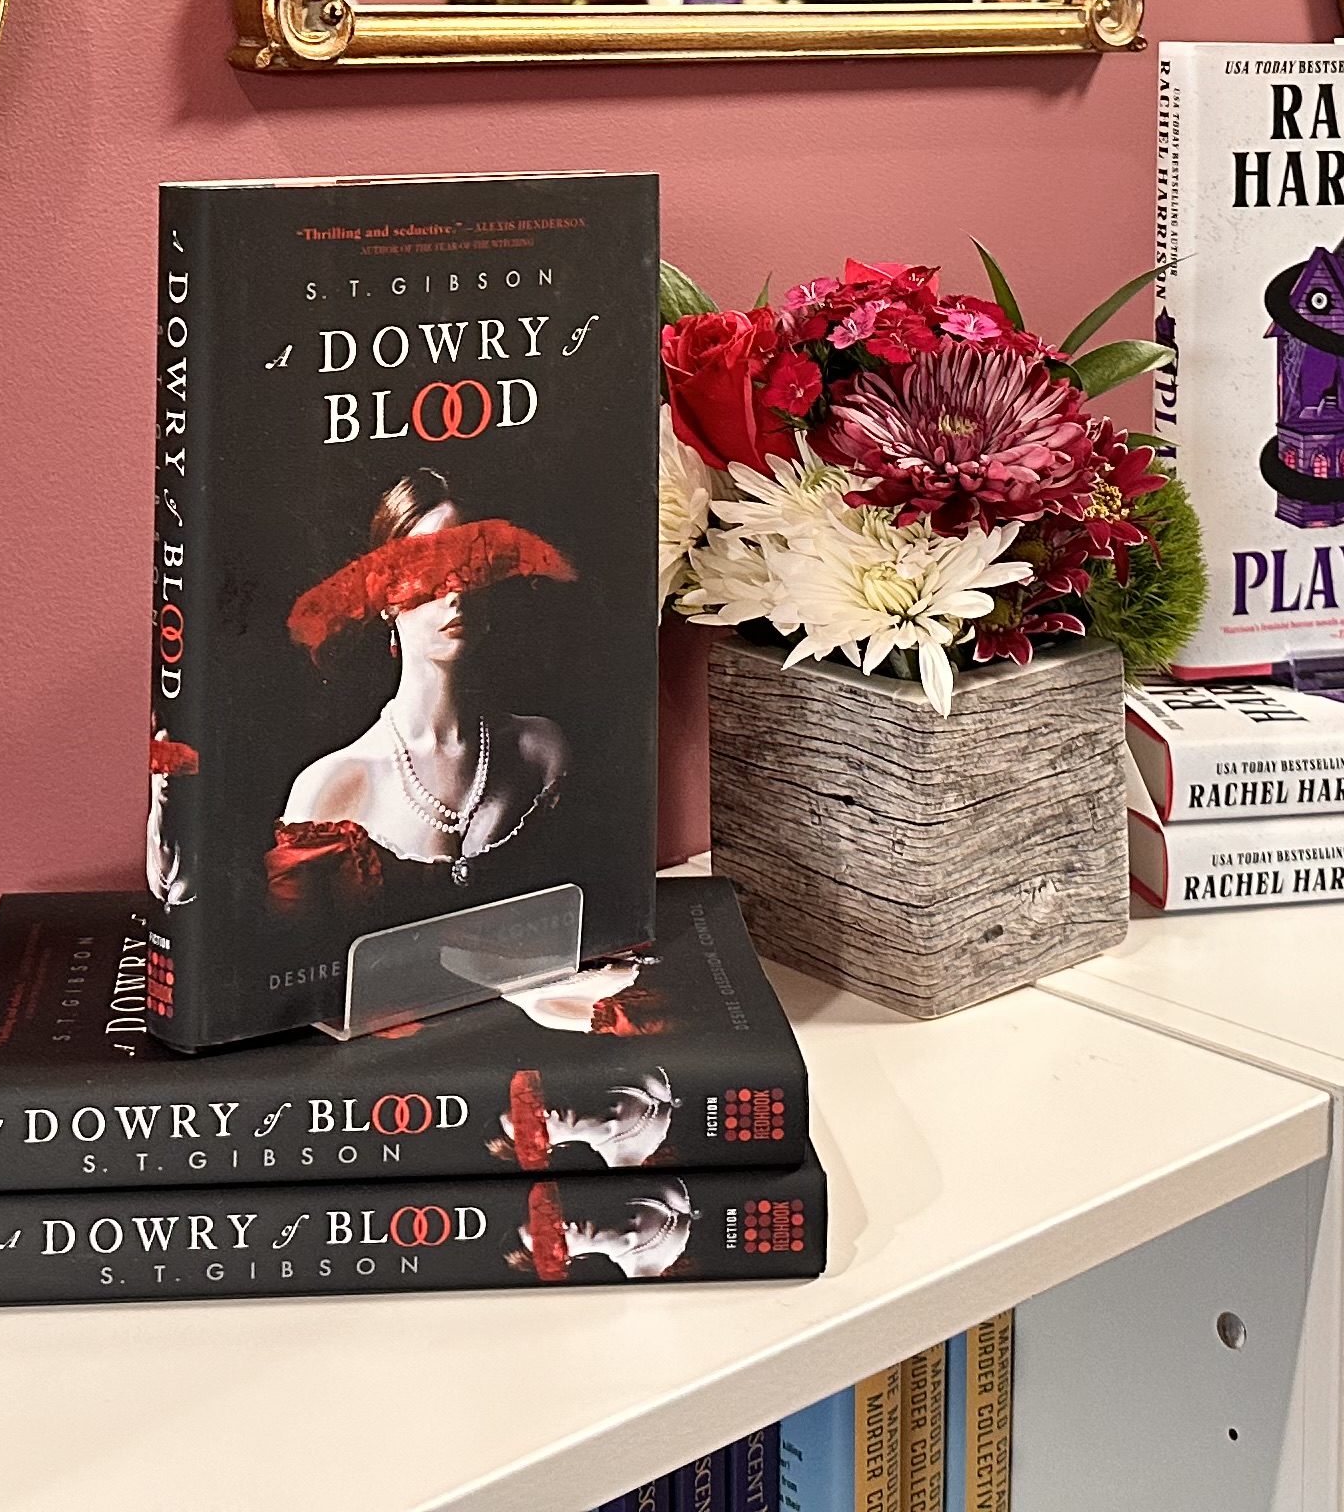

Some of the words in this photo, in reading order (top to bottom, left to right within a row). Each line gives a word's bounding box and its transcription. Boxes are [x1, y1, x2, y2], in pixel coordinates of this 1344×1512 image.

[1225, 60, 1249, 75] USA
[1255, 60, 1297, 74] TODAY
[1158, 60, 1171, 159] RACHEL
[365, 226, 389, 239] and
[518, 218, 587, 231] HENDERSON
[1155, 169, 1169, 300] HARRISON
[306, 282, 327, 300] S.
[349, 279, 371, 297] T.
[391, 268, 553, 295] GIBSON
[265, 343, 294, 371] A
[318, 315, 550, 373] DOWRY
[562, 313, 599, 357] of
[165, 271, 188, 477] DOWRY
[323, 378, 538, 444] BLOOD
[161, 541, 184, 699] BLOOD
[1216, 762, 1237, 775] USA
[1241, 760, 1278, 775] TODAY
[1188, 780, 1289, 809] RACHEL
[1211, 854, 1233, 867] USA
[1237, 851, 1273, 866] TODAY
[1184, 870, 1284, 901] RACHEL
[106, 937, 147, 1034] DOWRY
[269, 960, 341, 990] DESIRE
[23, 1102, 240, 1144] DOWRY
[254, 1101, 292, 1138] of
[308, 1093, 470, 1135] BLOOD
[706, 1097, 718, 1137] FICTION
[83, 1153, 108, 1173] S.
[136, 1152, 164, 1172] T.
[189, 1143, 401, 1170] GIBSON
[41, 1214, 258, 1256] DOWRY
[272, 1213, 310, 1251] of
[327, 1205, 488, 1248] BLOOD
[726, 1208, 738, 1249] FICTION
[772, 1201, 790, 1251] REDHOOK
[100, 1266, 126, 1285] S.
[154, 1264, 182, 1283] T.
[207, 1255, 419, 1281] GIBSON
[996, 1324, 1010, 1431] MARIGOLD
[866, 1391, 884, 1482] MURDER
[929, 1358, 943, 1466] MARIGOLD
[976, 1403, 994, 1511] COLLECTIV
